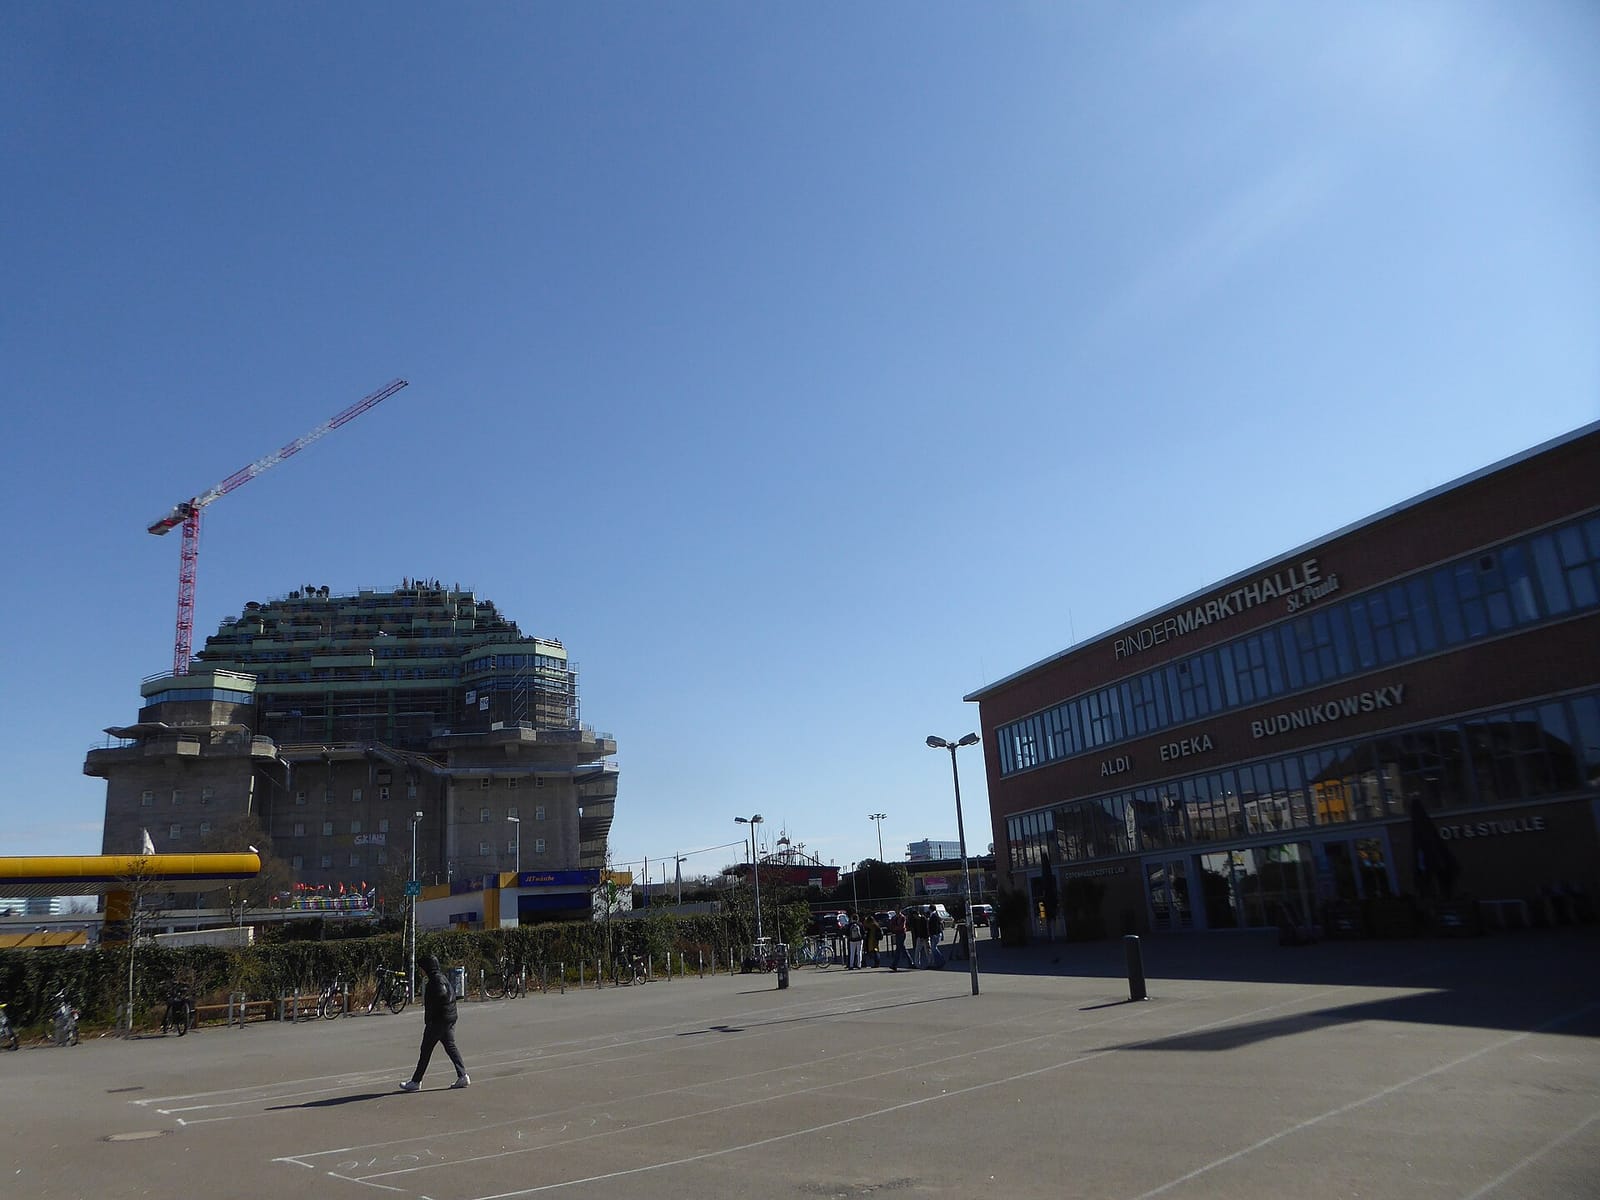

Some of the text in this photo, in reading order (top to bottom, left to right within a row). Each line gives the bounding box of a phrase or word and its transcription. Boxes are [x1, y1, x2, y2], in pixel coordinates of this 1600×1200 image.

[1114, 558, 1321, 661] RINDERMARKTHALLE
[1251, 684, 1405, 739] BUDNIKOWSKY
[1160, 734, 1213, 762] EDEKA
[1100, 755, 1131, 777] ALDI
[1478, 816, 1544, 836] STULLE
